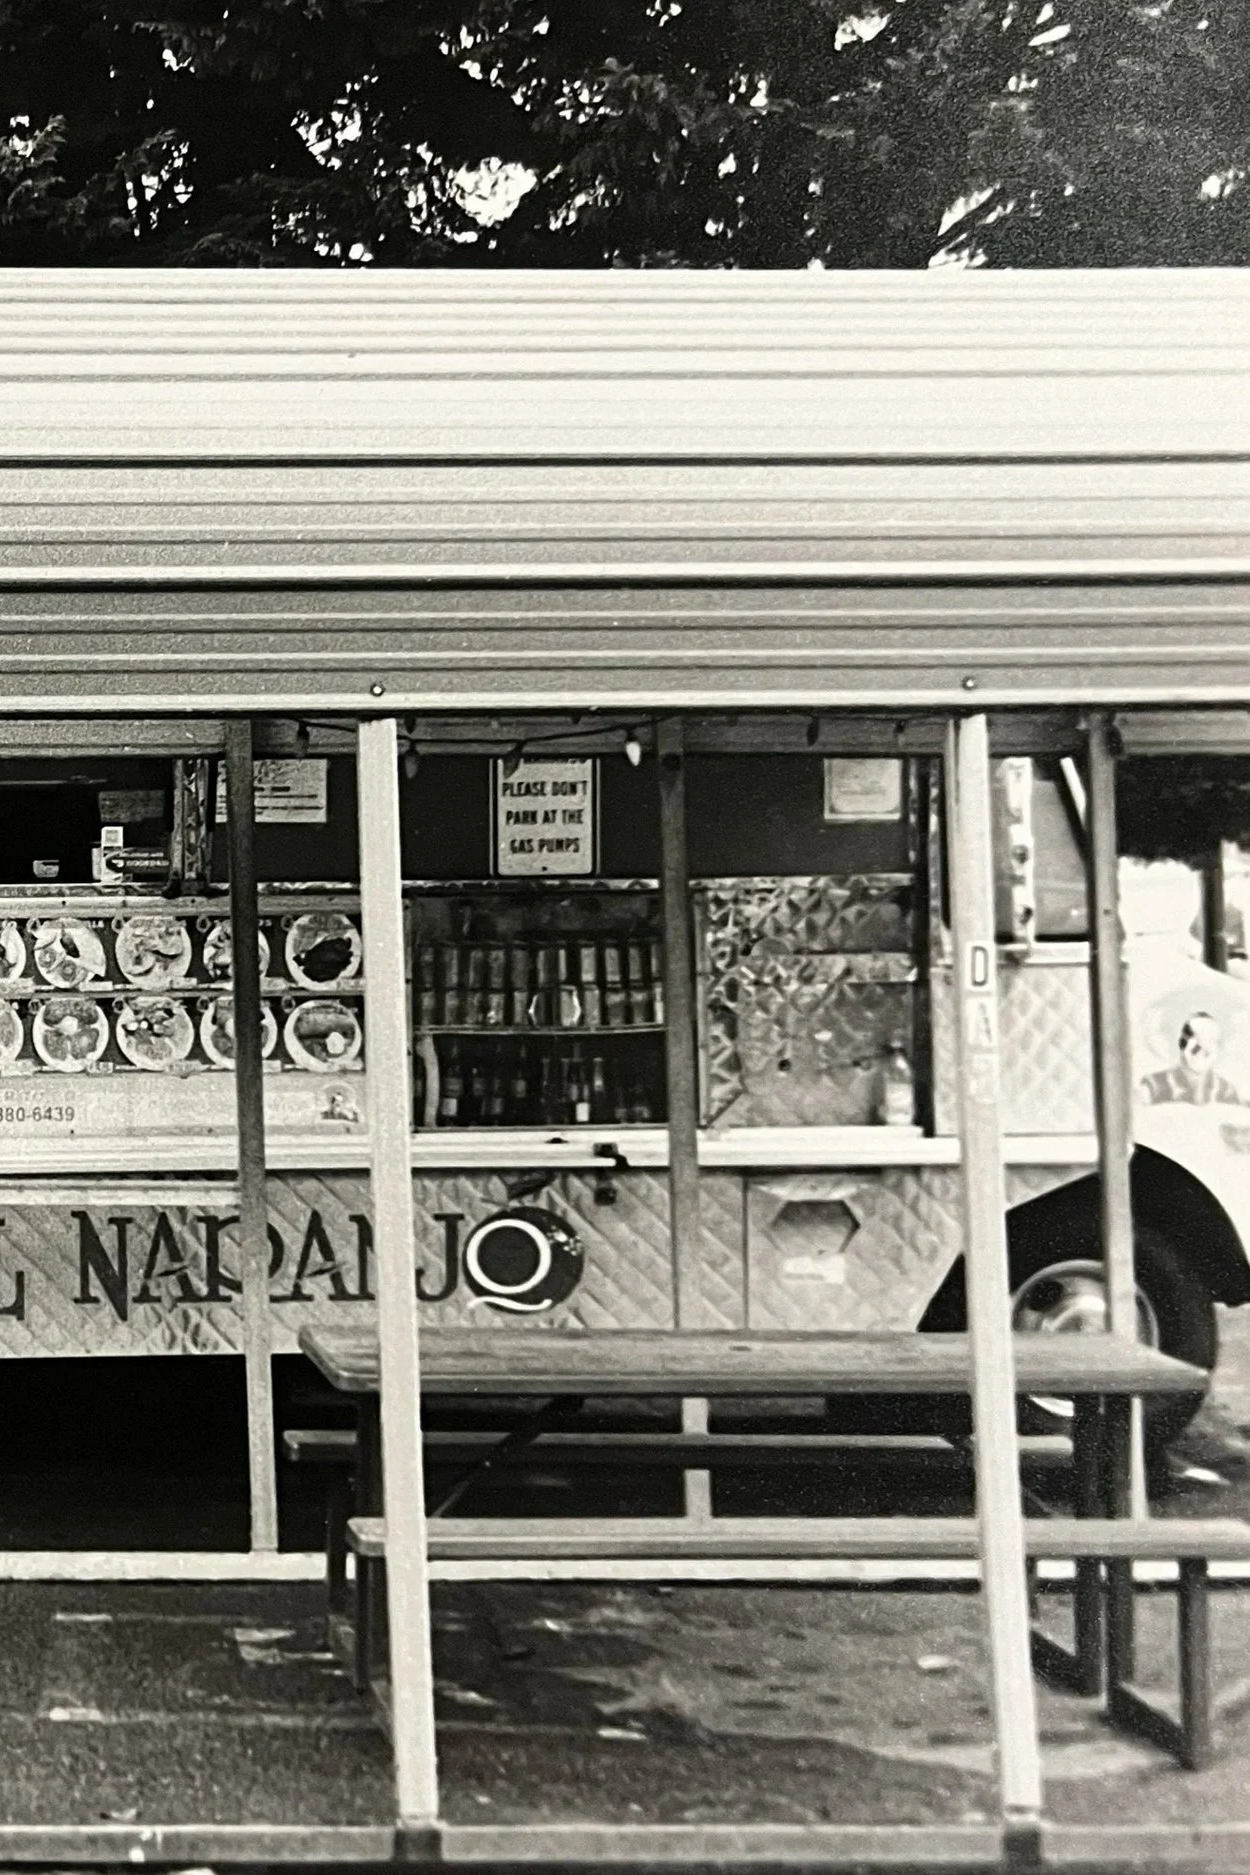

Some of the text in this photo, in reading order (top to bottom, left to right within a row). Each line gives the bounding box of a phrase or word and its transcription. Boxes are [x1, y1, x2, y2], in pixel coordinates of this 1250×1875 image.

[502, 781, 547, 797] PLEASE
[506, 809, 584, 825] PARK AT THE
[510, 837, 580, 854] GAS PUMPS
